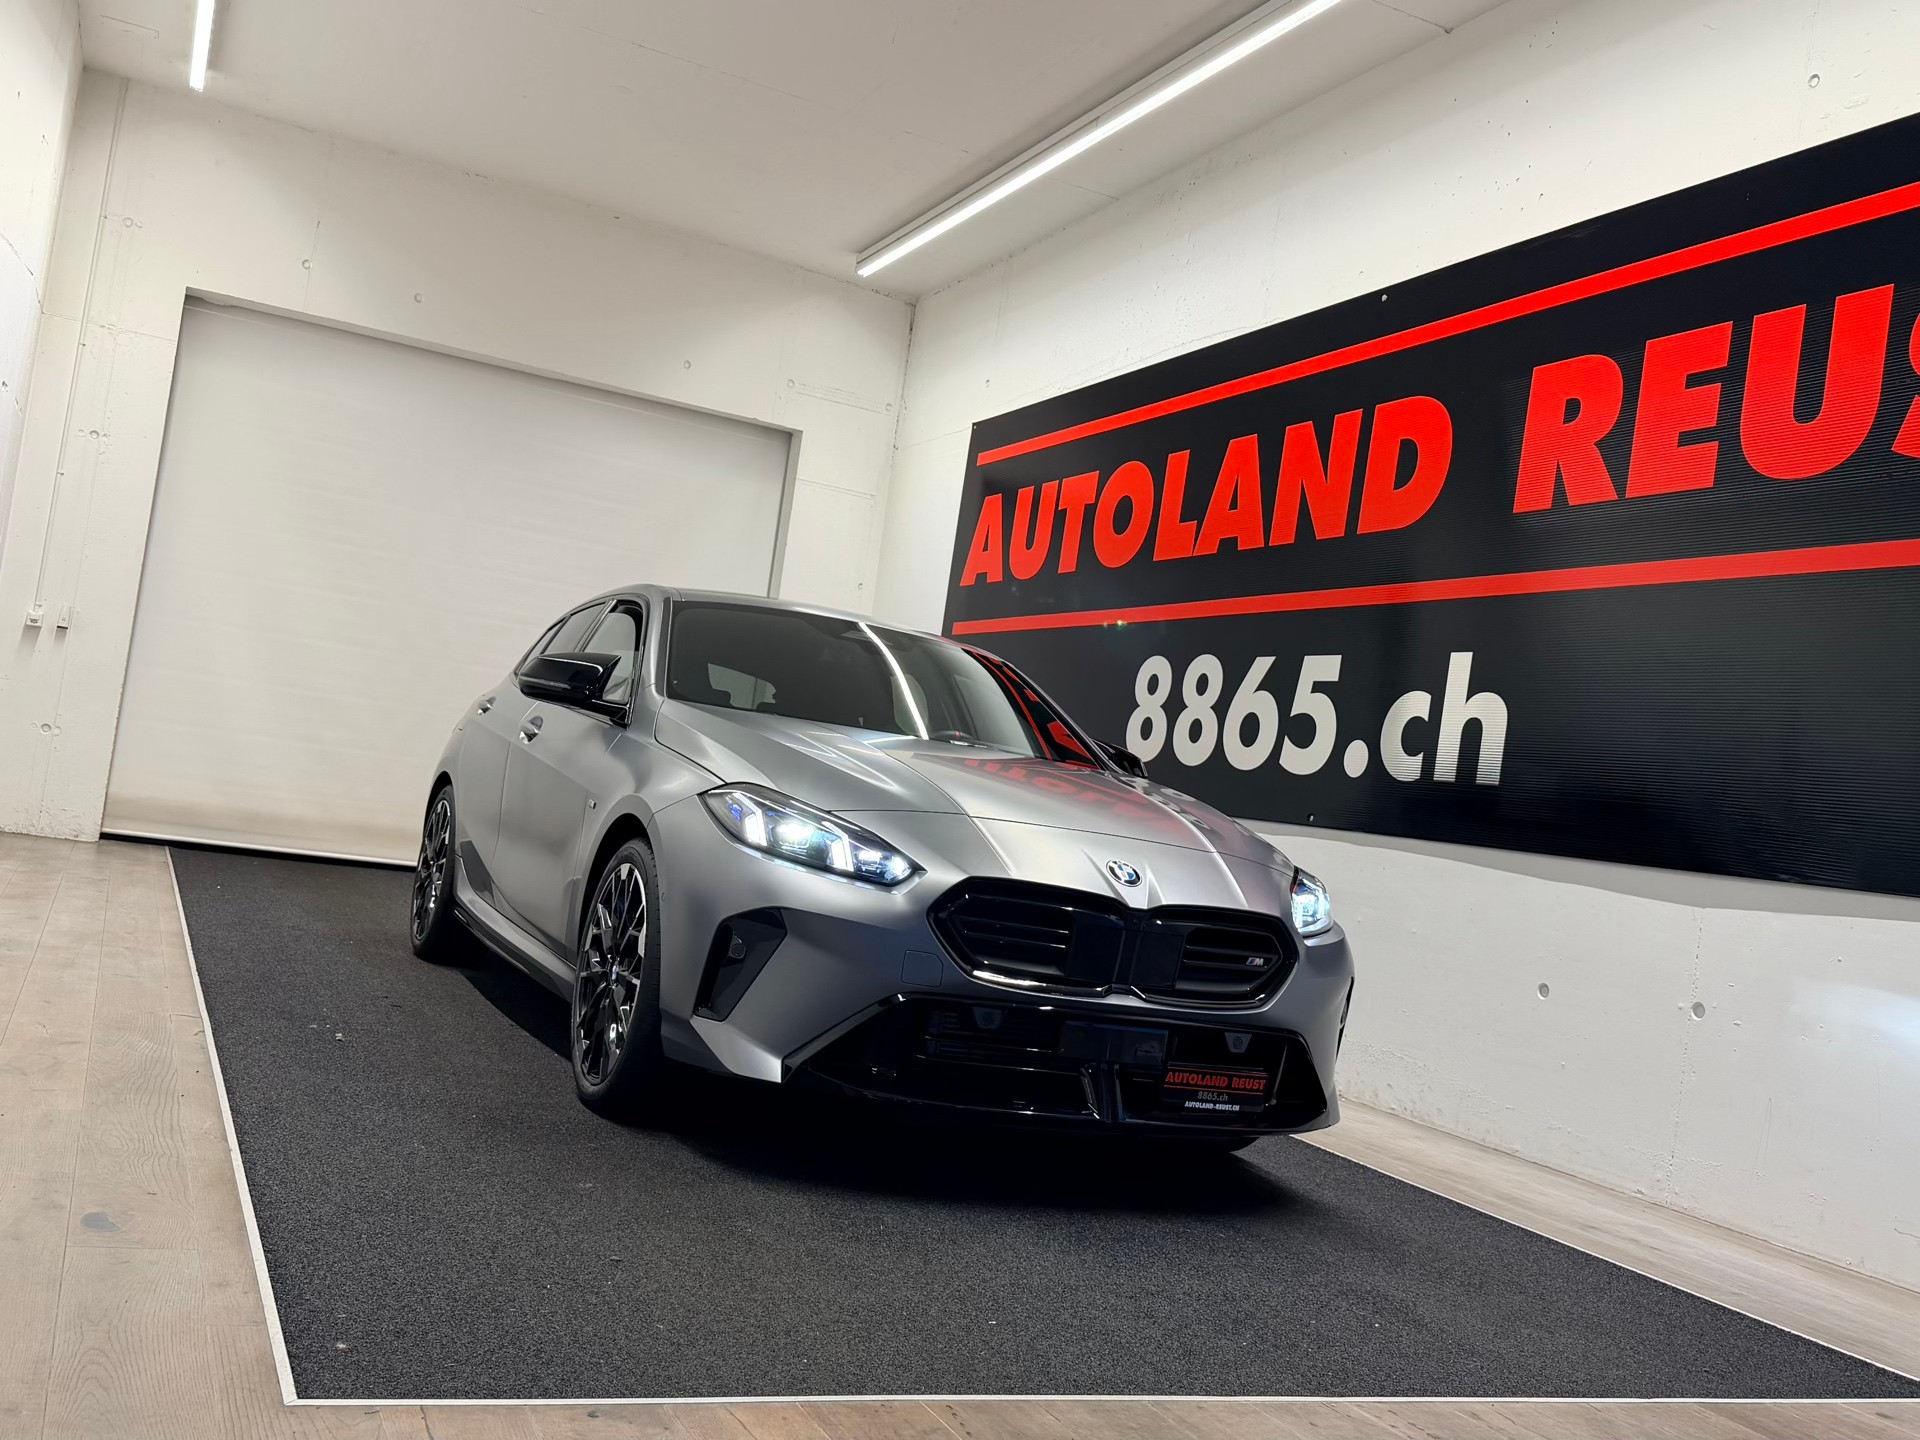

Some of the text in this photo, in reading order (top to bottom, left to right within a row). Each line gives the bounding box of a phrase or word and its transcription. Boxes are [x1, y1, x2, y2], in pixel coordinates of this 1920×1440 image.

[960, 284, 1920, 586] AUTOLAND REU
[1126, 651, 1508, 786] 8865.ch
[1165, 1072, 1266, 1090] AUTOLAND REUST
[1197, 1091, 1228, 1102] 8865.ch
[1184, 1101, 1240, 1111] AUTOLAND-REUST.CH
